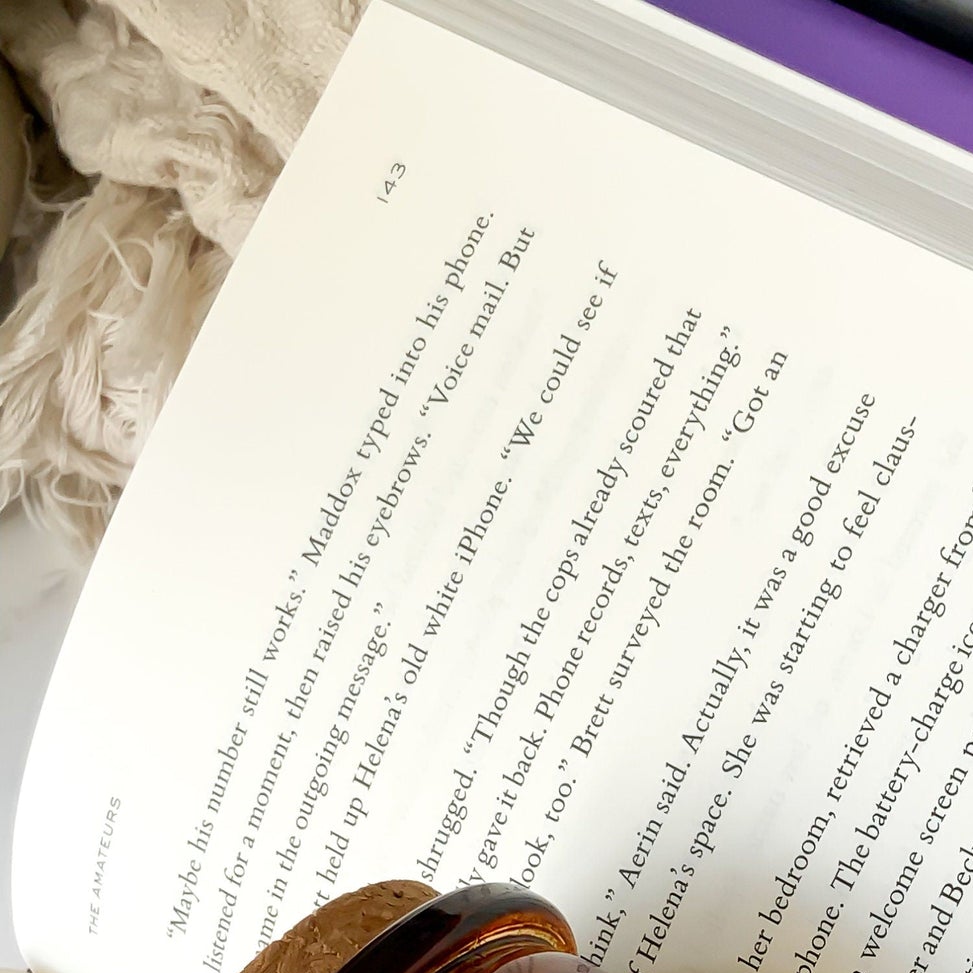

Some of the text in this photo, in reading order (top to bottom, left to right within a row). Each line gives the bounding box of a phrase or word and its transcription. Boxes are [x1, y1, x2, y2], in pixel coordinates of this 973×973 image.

[376, 161, 407, 204] 143
[497, 226, 536, 273] But
[468, 280, 510, 339] mail.
[418, 342, 475, 417] “Voice
[365, 432, 432, 548] eyebrows.
[167, 212, 495, 939] “Maybe his number still works.” Maddox typed into his phone.
[337, 551, 371, 588] his
[415, 307, 702, 880] shrugged. “Though the cops already scoured that
[311, 588, 352, 664] raised
[508, 351, 788, 890] look, too.” Brett surveyed the room. “Got an
[283, 667, 320, 720] then
[579, 392, 876, 969] hink,” Aerin said. Actually, it was a good excuse
[247, 729, 298, 831] moment,
[265, 601, 392, 902] in the outgoing message.”
[829, 843, 871, 892] The
[853, 659, 965, 841] battery-charge
[87, 795, 122, 935] THE AMATEURS
[222, 850, 249, 888] for
[241, 835, 256, 849] a
[859, 850, 924, 959] welcome
[918, 766, 969, 846] screen
[201, 886, 238, 973] listened
